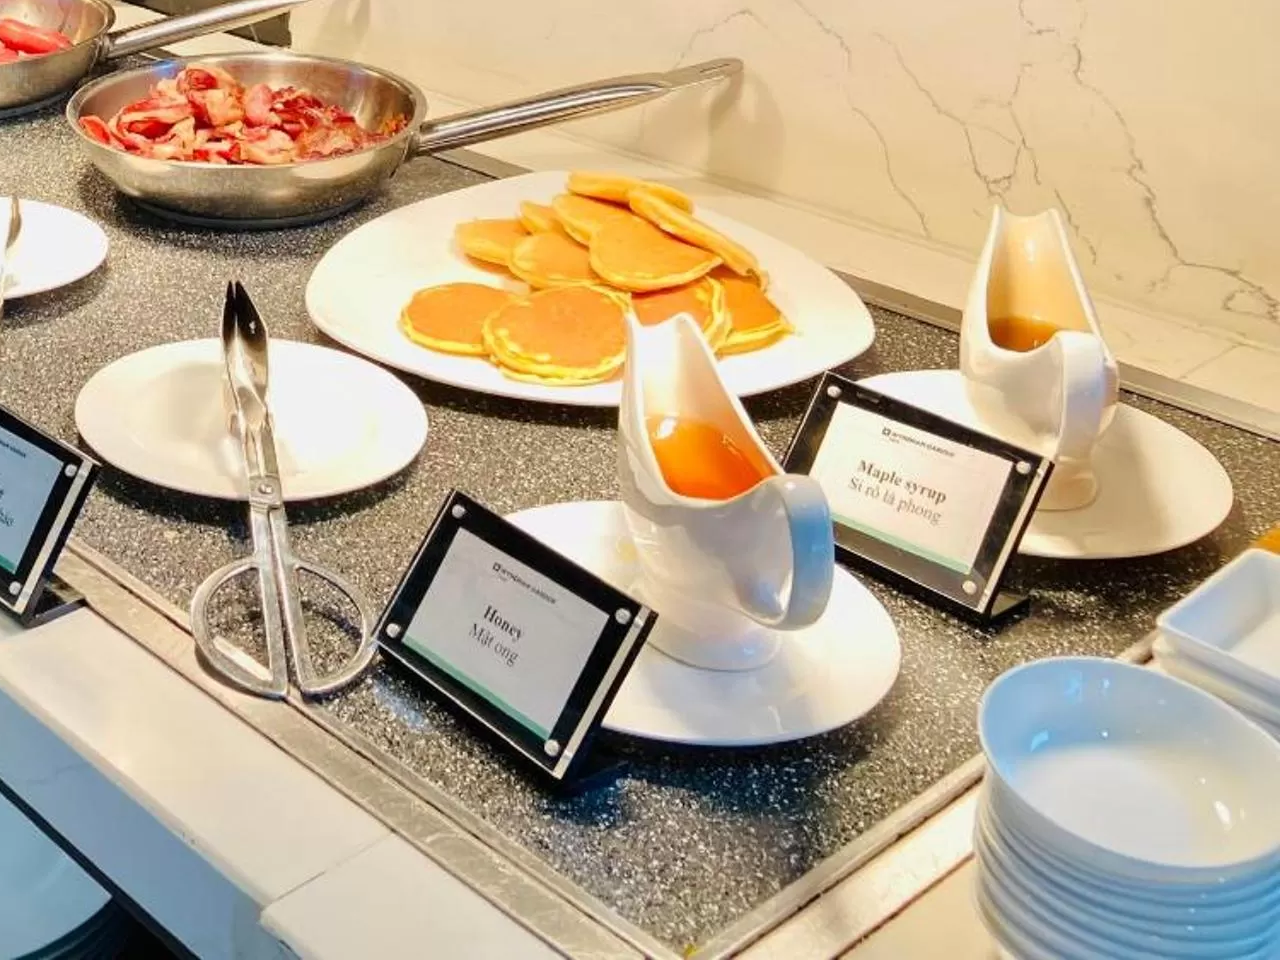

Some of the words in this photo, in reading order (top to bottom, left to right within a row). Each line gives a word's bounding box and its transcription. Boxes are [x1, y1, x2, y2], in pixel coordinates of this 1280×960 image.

[857, 458, 902, 487] Maple
[904, 479, 947, 505] syrup
[896, 497, 942, 526] phong
[483, 604, 521, 643] Honey
[494, 642, 520, 668] ong
